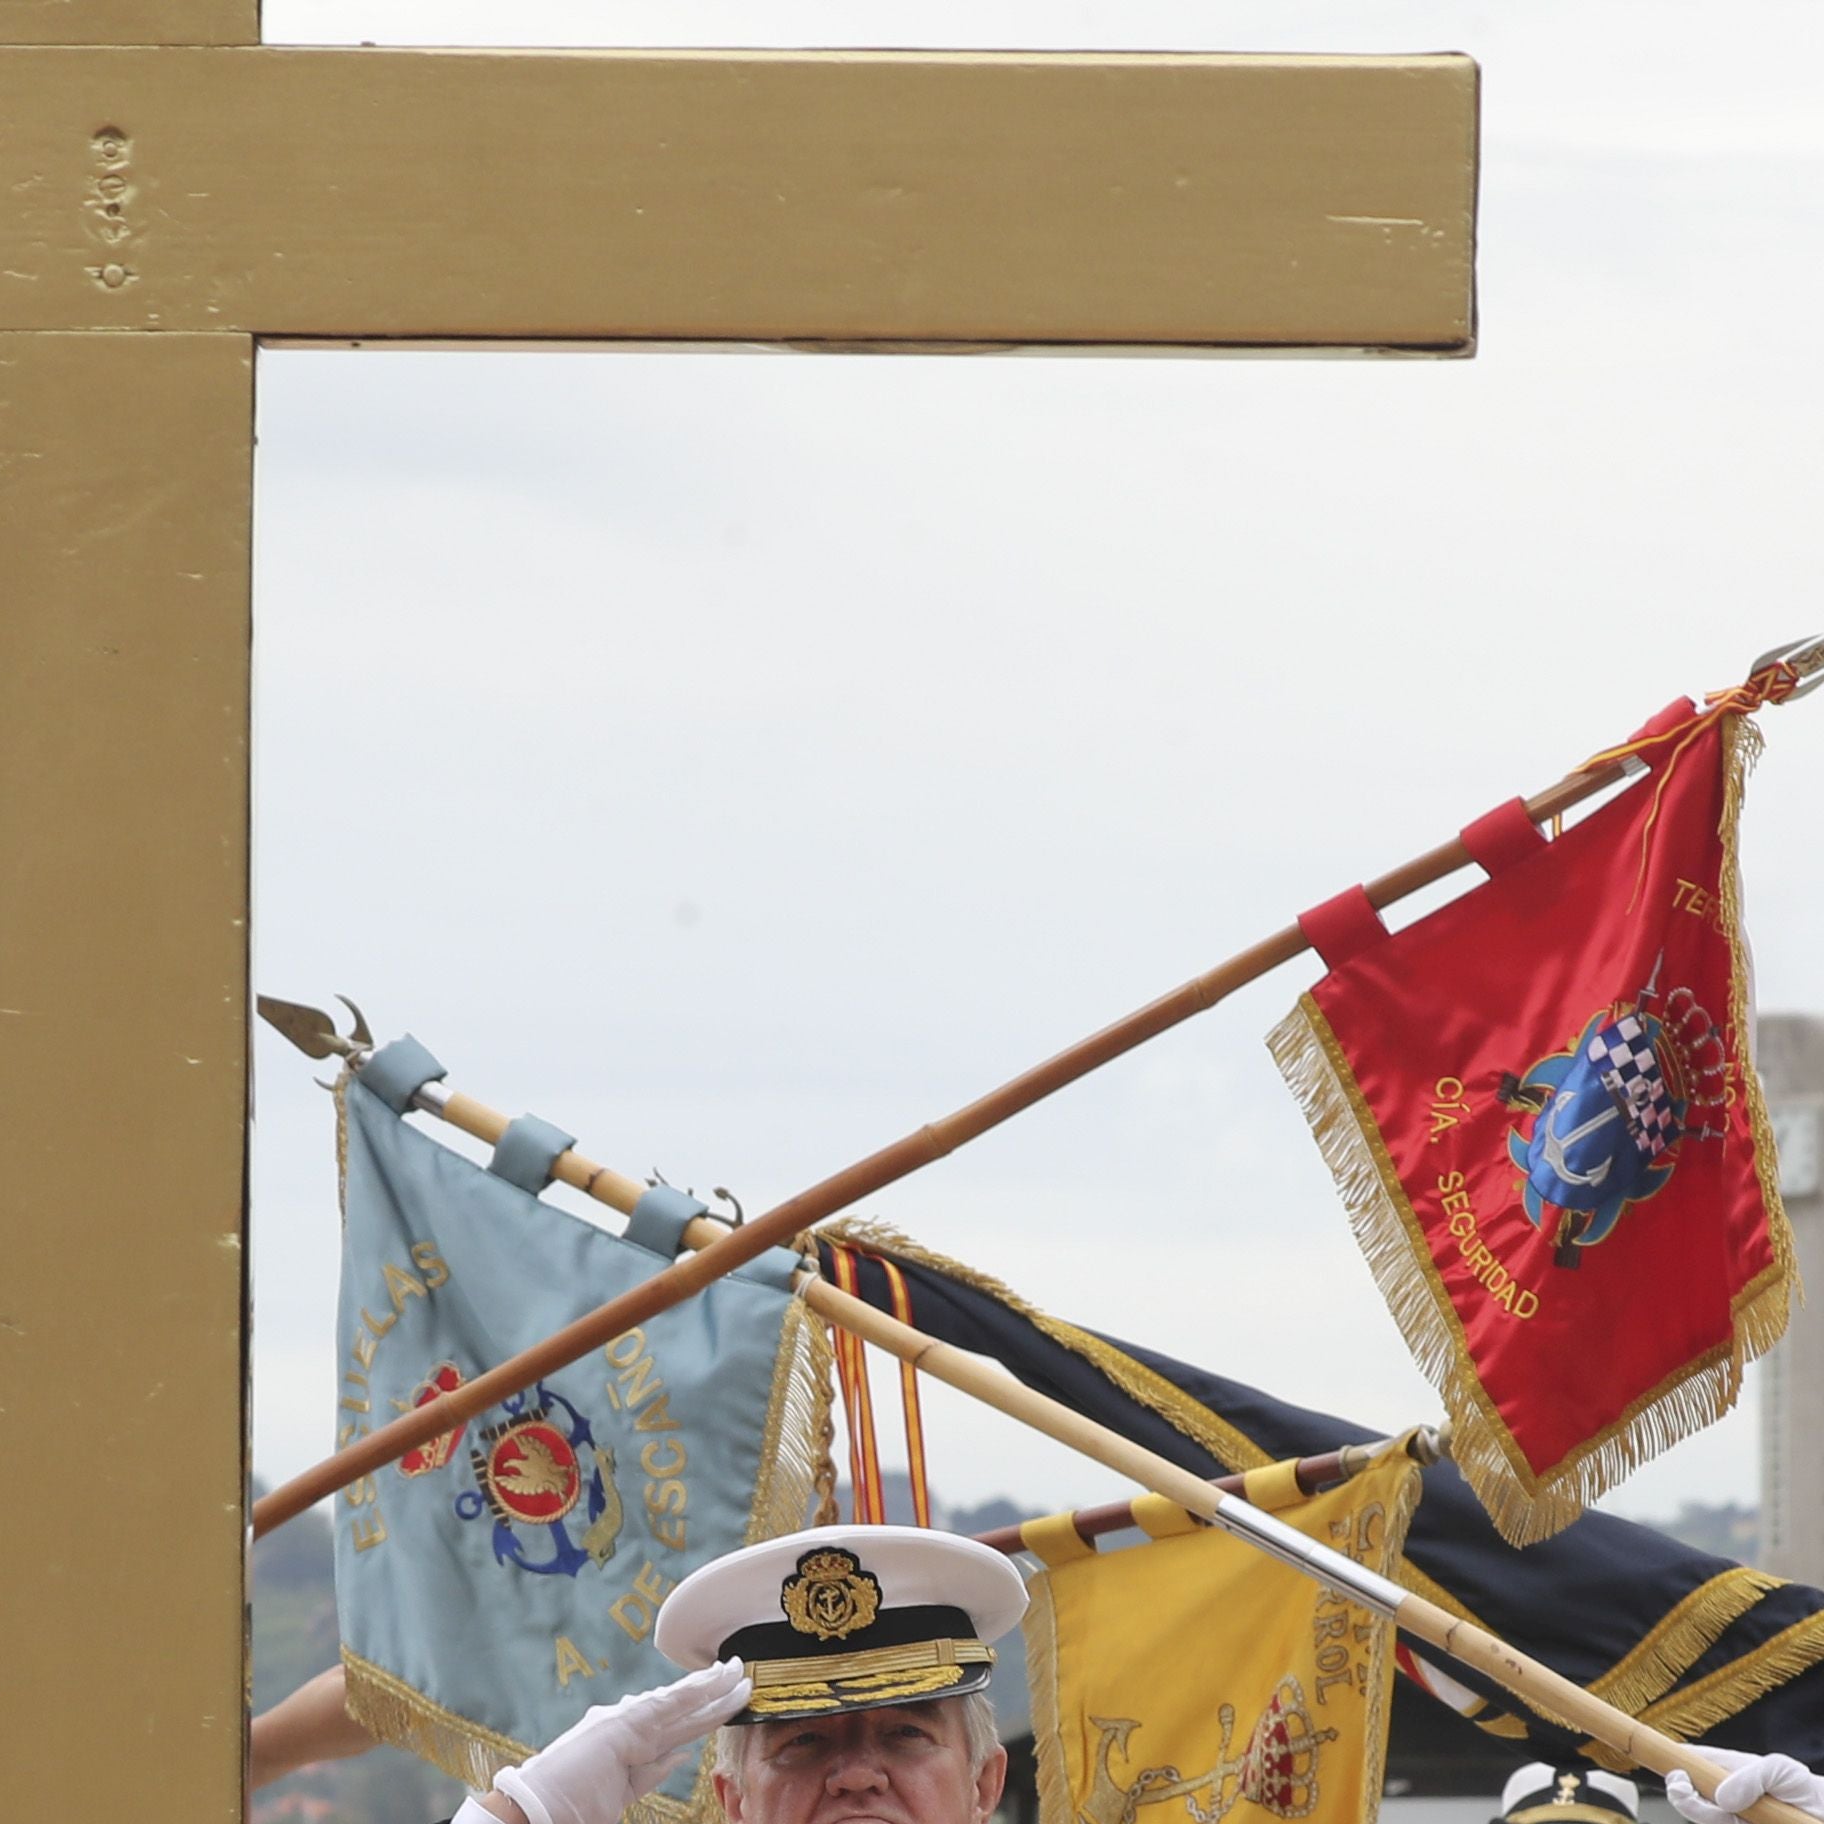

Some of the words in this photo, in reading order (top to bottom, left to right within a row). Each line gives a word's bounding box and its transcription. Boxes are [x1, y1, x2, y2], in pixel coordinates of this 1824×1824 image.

[1429, 1076, 1471, 1144] CÍA.
[1438, 1170, 1540, 1320] SEGURIDAD
[606, 1326, 689, 1552] ESCAÑO
[608, 1561, 678, 1643] DE
